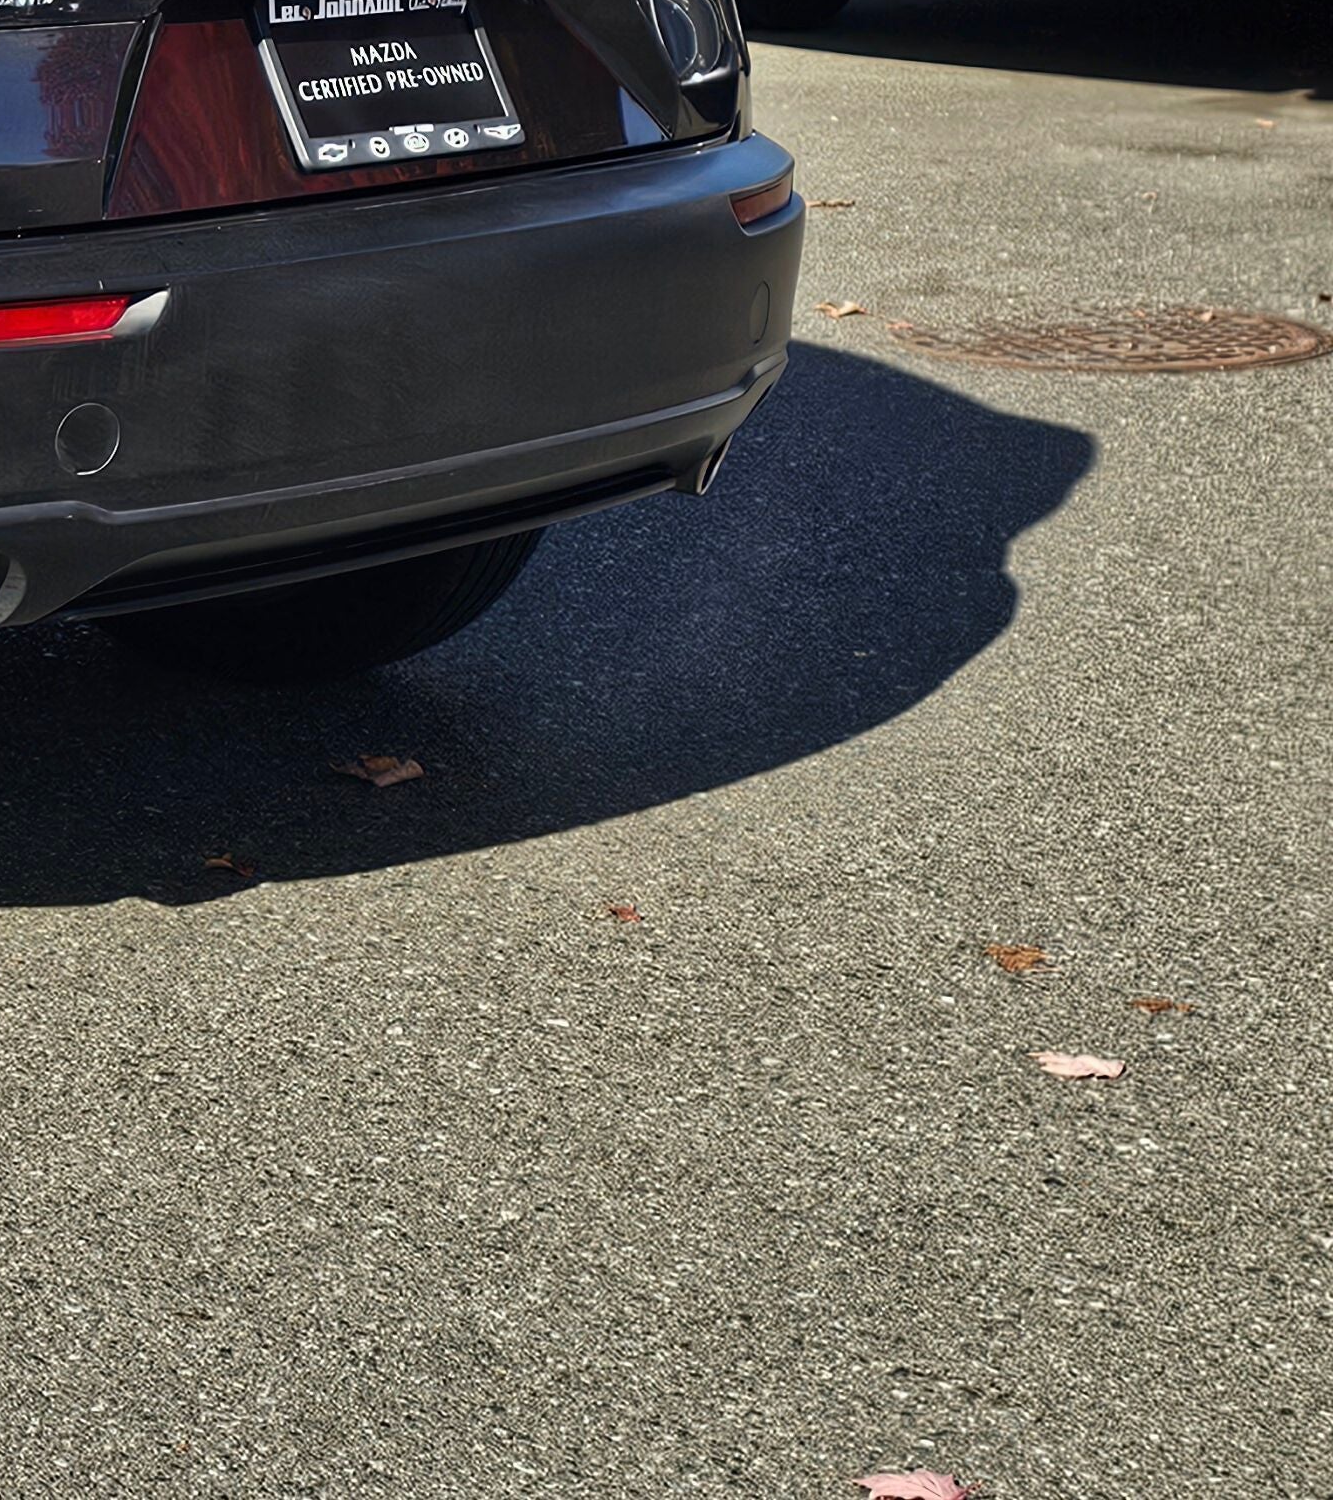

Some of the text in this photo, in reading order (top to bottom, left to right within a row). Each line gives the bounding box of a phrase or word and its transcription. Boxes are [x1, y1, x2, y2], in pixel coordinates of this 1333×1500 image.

[349, 41, 418, 67] MAZDA
[298, 61, 485, 102] CERTIFIED PRE-OWNED
